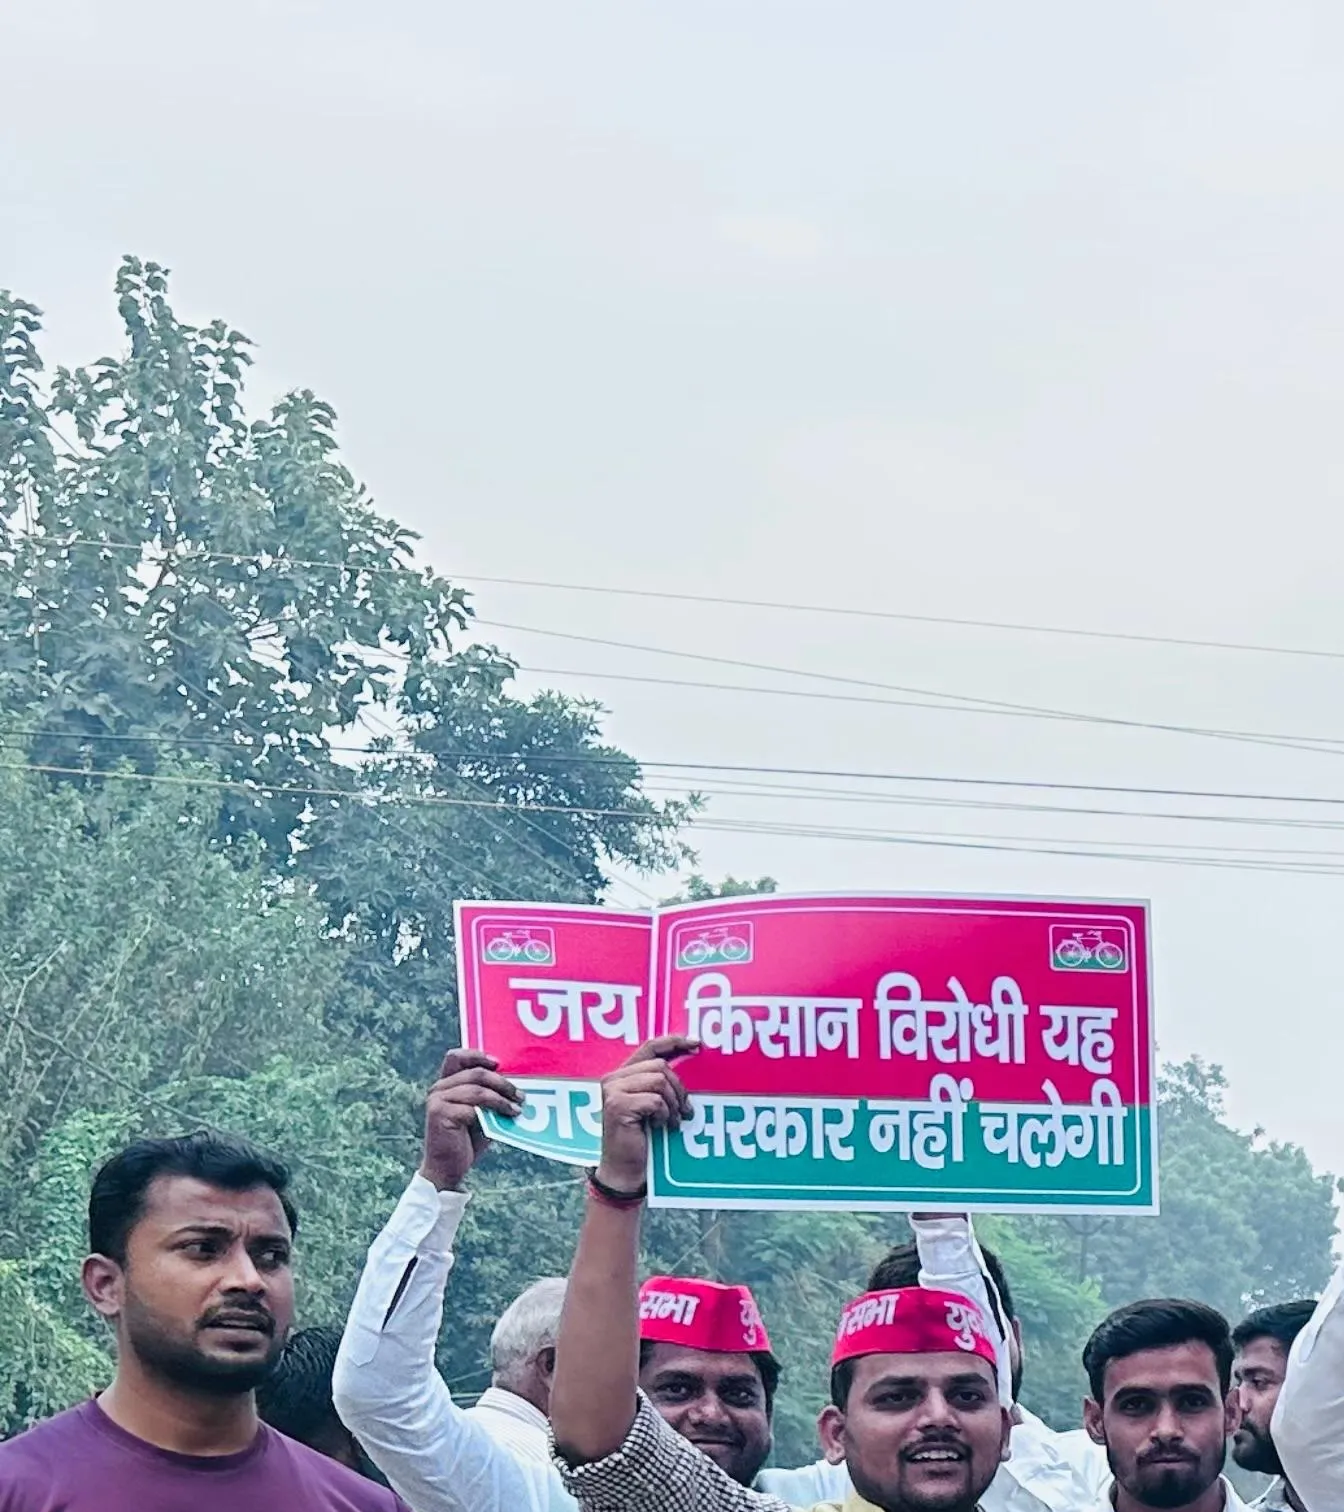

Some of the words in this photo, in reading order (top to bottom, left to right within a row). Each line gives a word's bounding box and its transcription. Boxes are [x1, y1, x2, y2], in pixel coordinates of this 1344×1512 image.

[508, 976, 645, 1046] जय
[685, 970, 863, 1060] किसान
[873, 970, 1029, 1065] विरोधी
[1039, 1004, 1118, 1074] यह
[677, 1097, 856, 1163] सरकार
[865, 1072, 976, 1171] नहीं
[979, 1078, 1128, 1168] चलेगी
[639, 1291, 701, 1326] सभा
[847, 1293, 899, 1337] सभा
